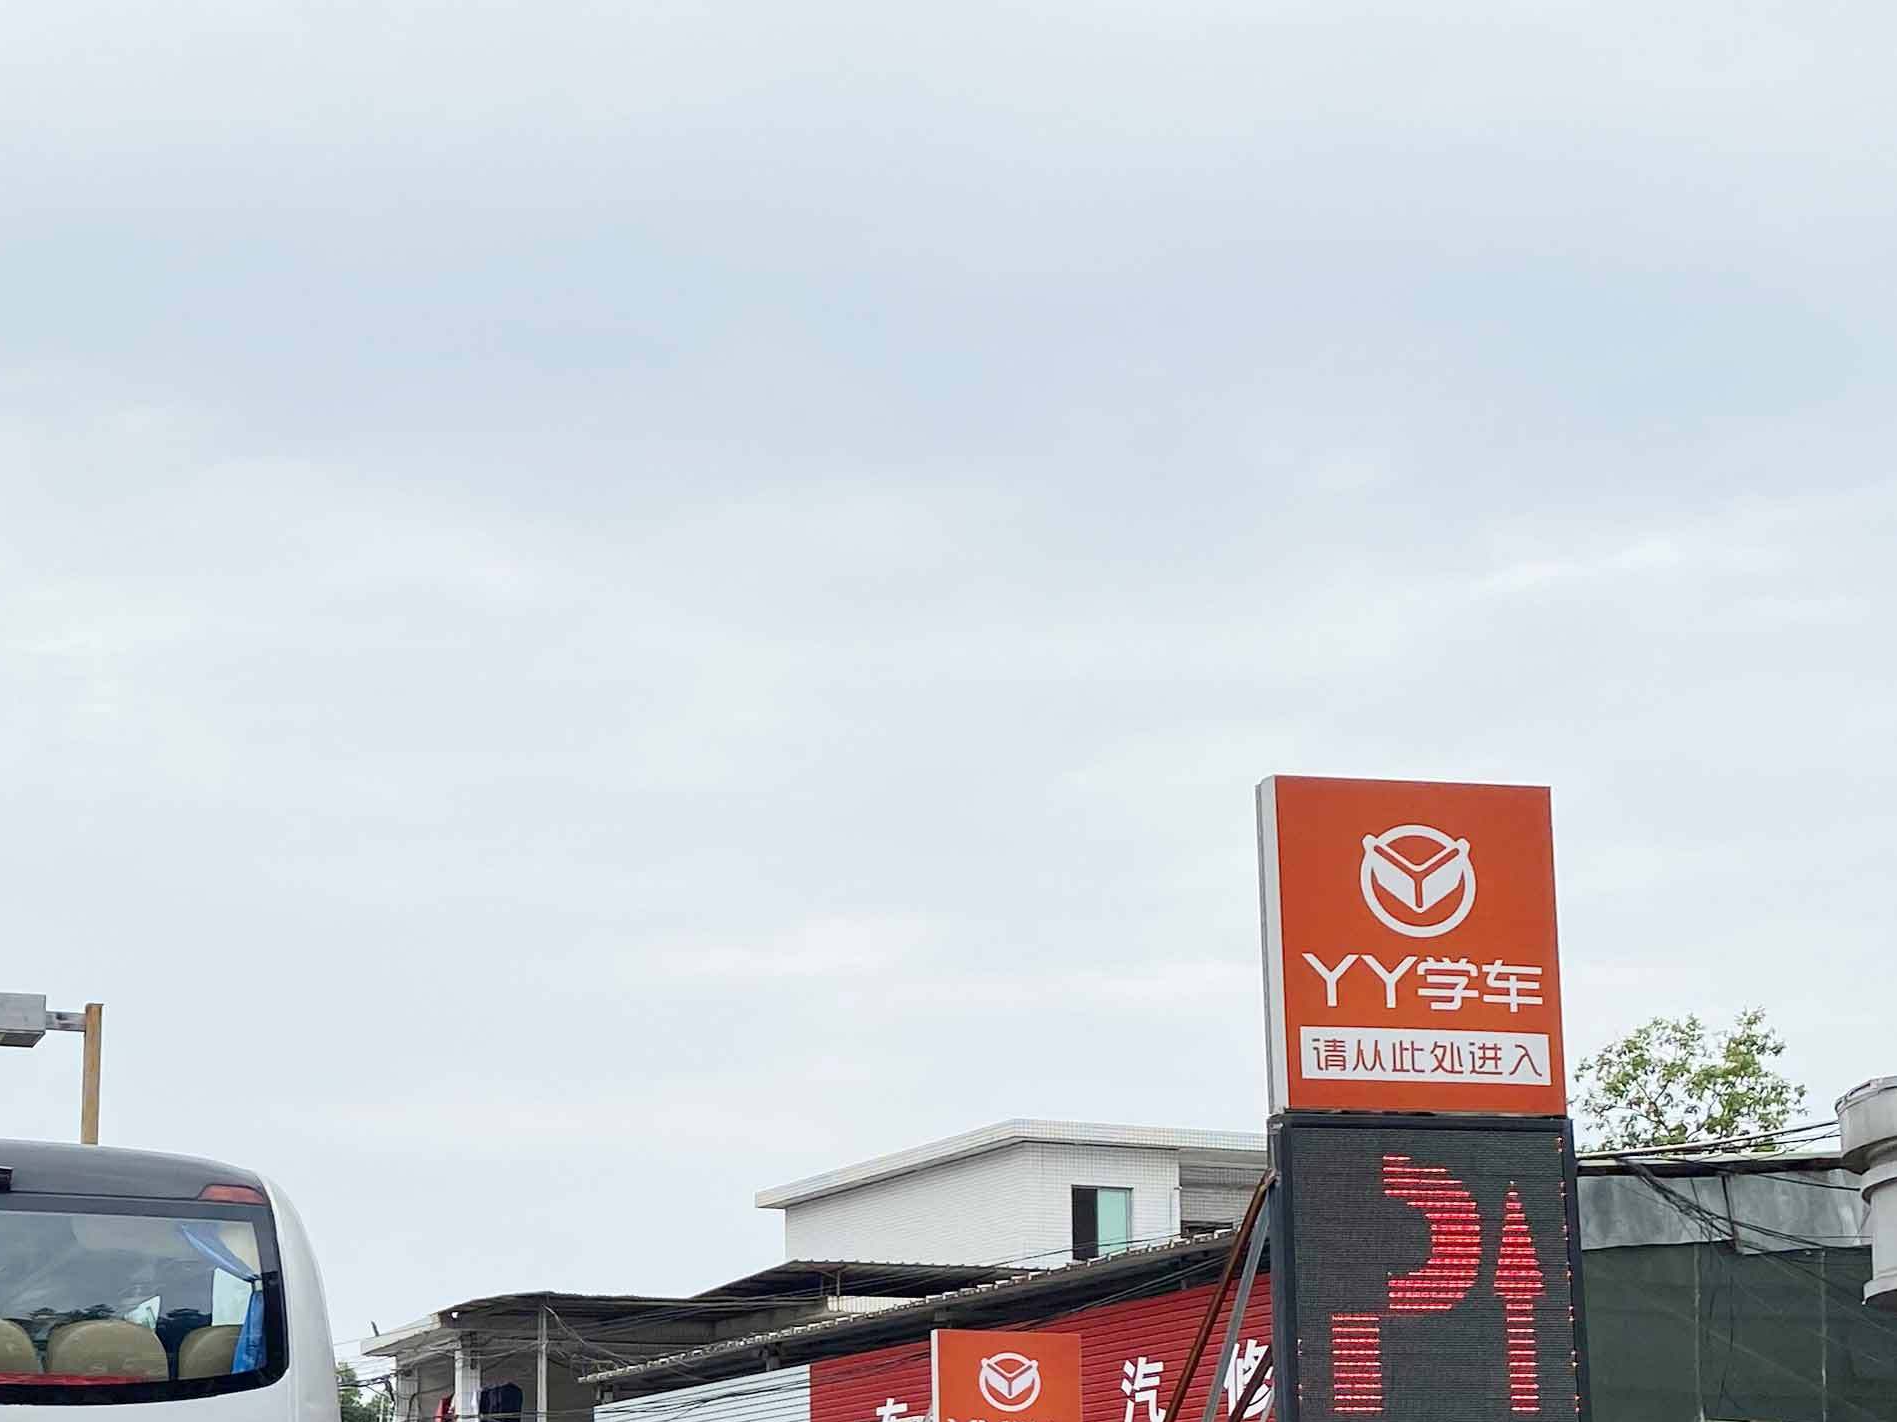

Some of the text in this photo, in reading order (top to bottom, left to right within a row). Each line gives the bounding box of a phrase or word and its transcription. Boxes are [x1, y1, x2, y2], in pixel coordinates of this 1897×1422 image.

[1302, 953, 1543, 1012] YY学车
[1312, 1038, 1542, 1077] 请从此处进入
